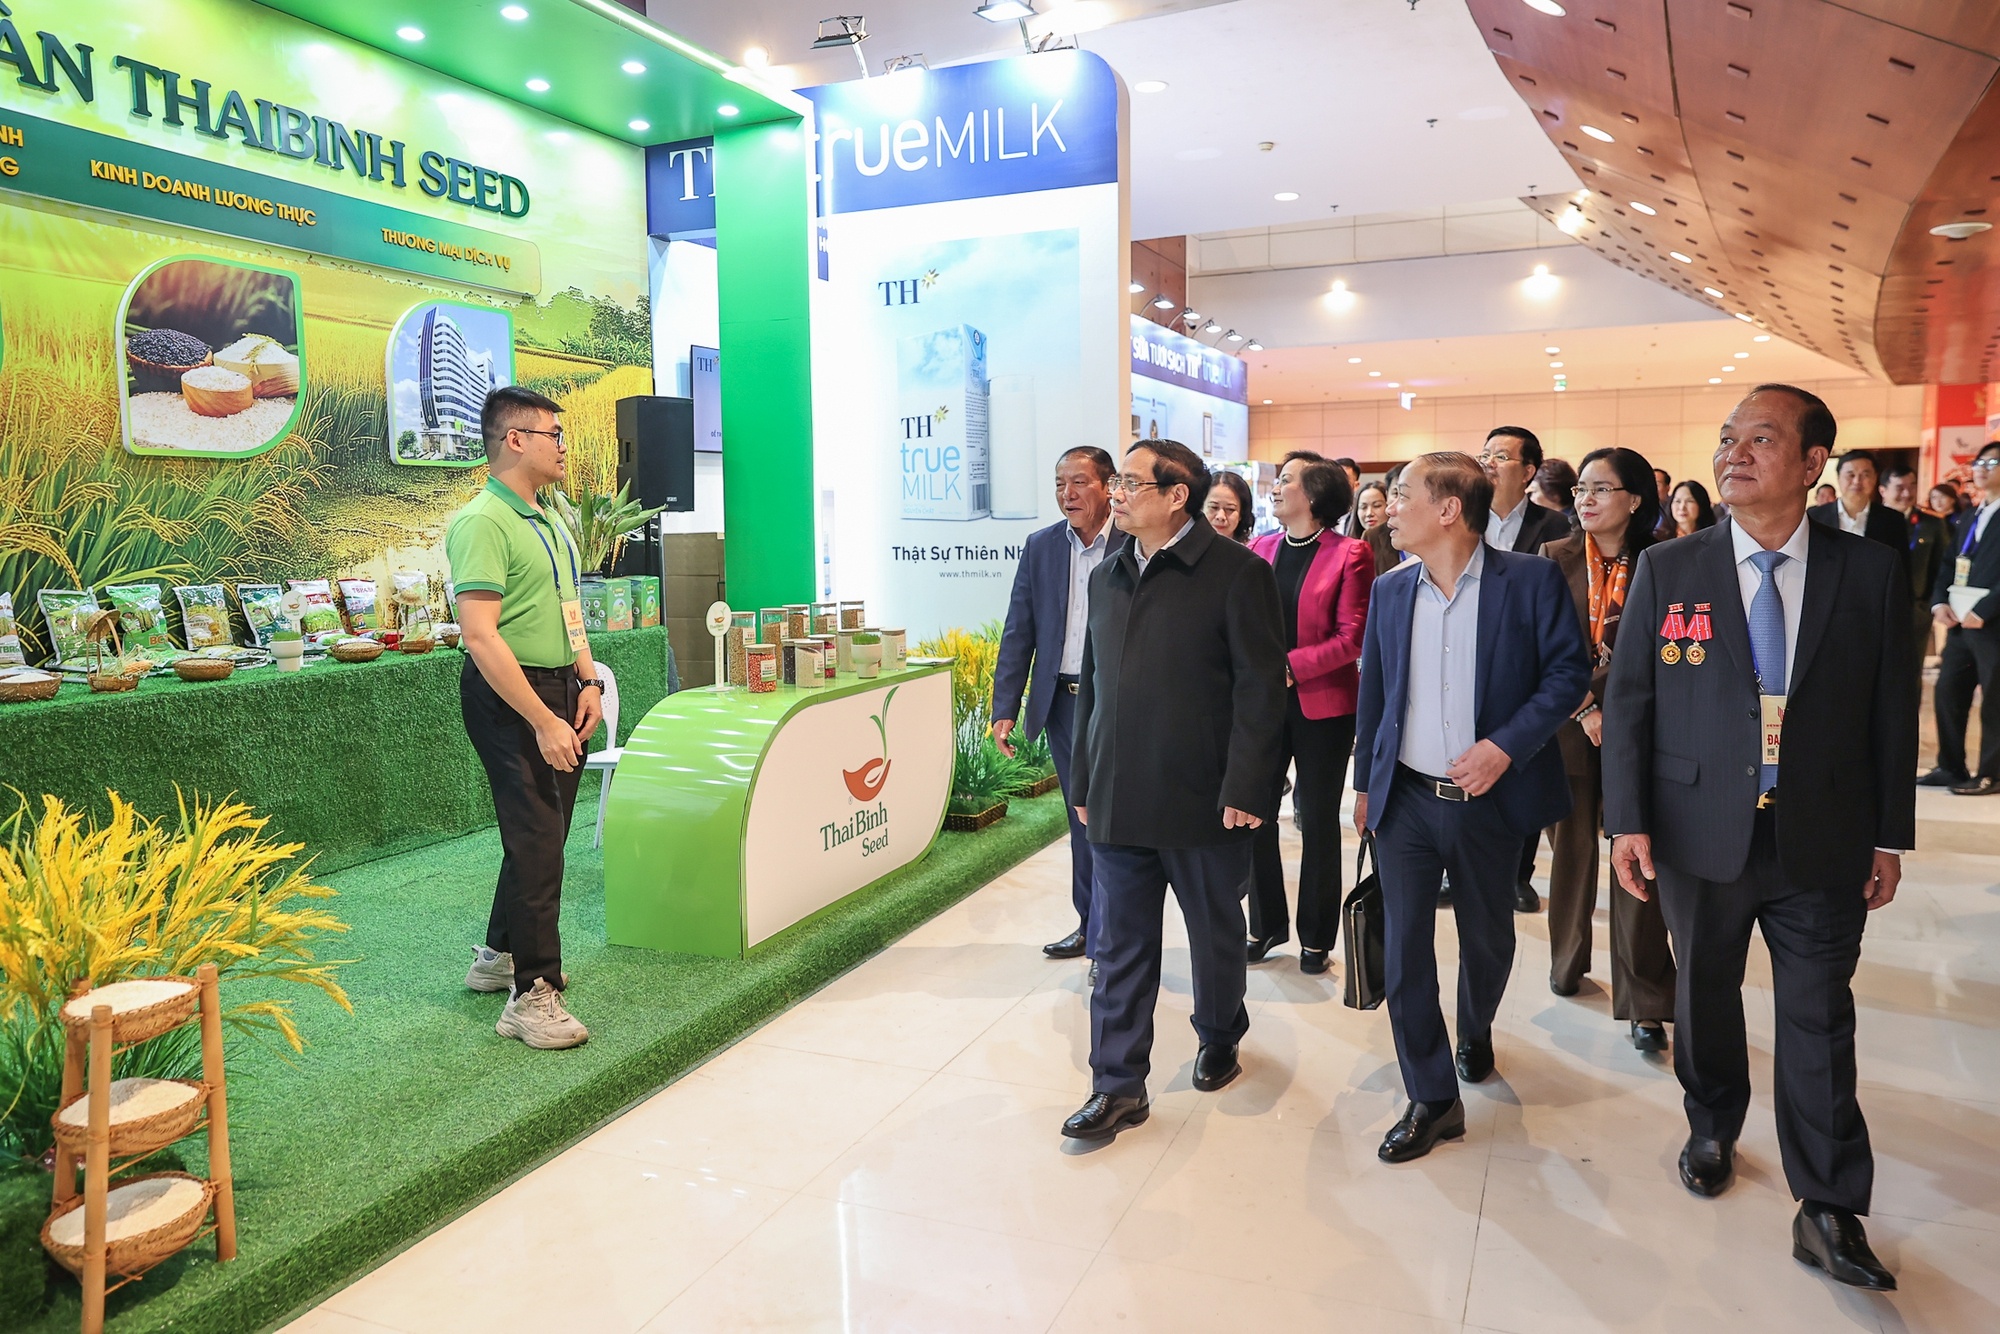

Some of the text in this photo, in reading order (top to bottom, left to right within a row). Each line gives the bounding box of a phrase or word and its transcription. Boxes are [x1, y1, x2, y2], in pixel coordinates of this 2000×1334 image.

[114, 55, 407, 187] THAIBINH
[418, 151, 530, 218] SEED
[90, 159, 317, 226] KINH DOANH LƯƠNG THỰC
[381, 228, 511, 272] THƯƠNG MẠI DỊCH VỤ
[877, 278, 921, 307] TH
[696, 356, 713, 373] TH
[900, 414, 933, 440] TH
[900, 443, 961, 473] true
[903, 473, 962, 501] MILK
[892, 546, 927, 564] Thật
[930, 546, 951, 564] Sự
[954, 545, 999, 561] Thiên
[939, 570, 1002, 578] www.thmilk.vn
[1766, 734, 1780, 748] ĐẠ
[819, 801, 888, 852] ThaiBinh
[861, 828, 889, 857] Seed
